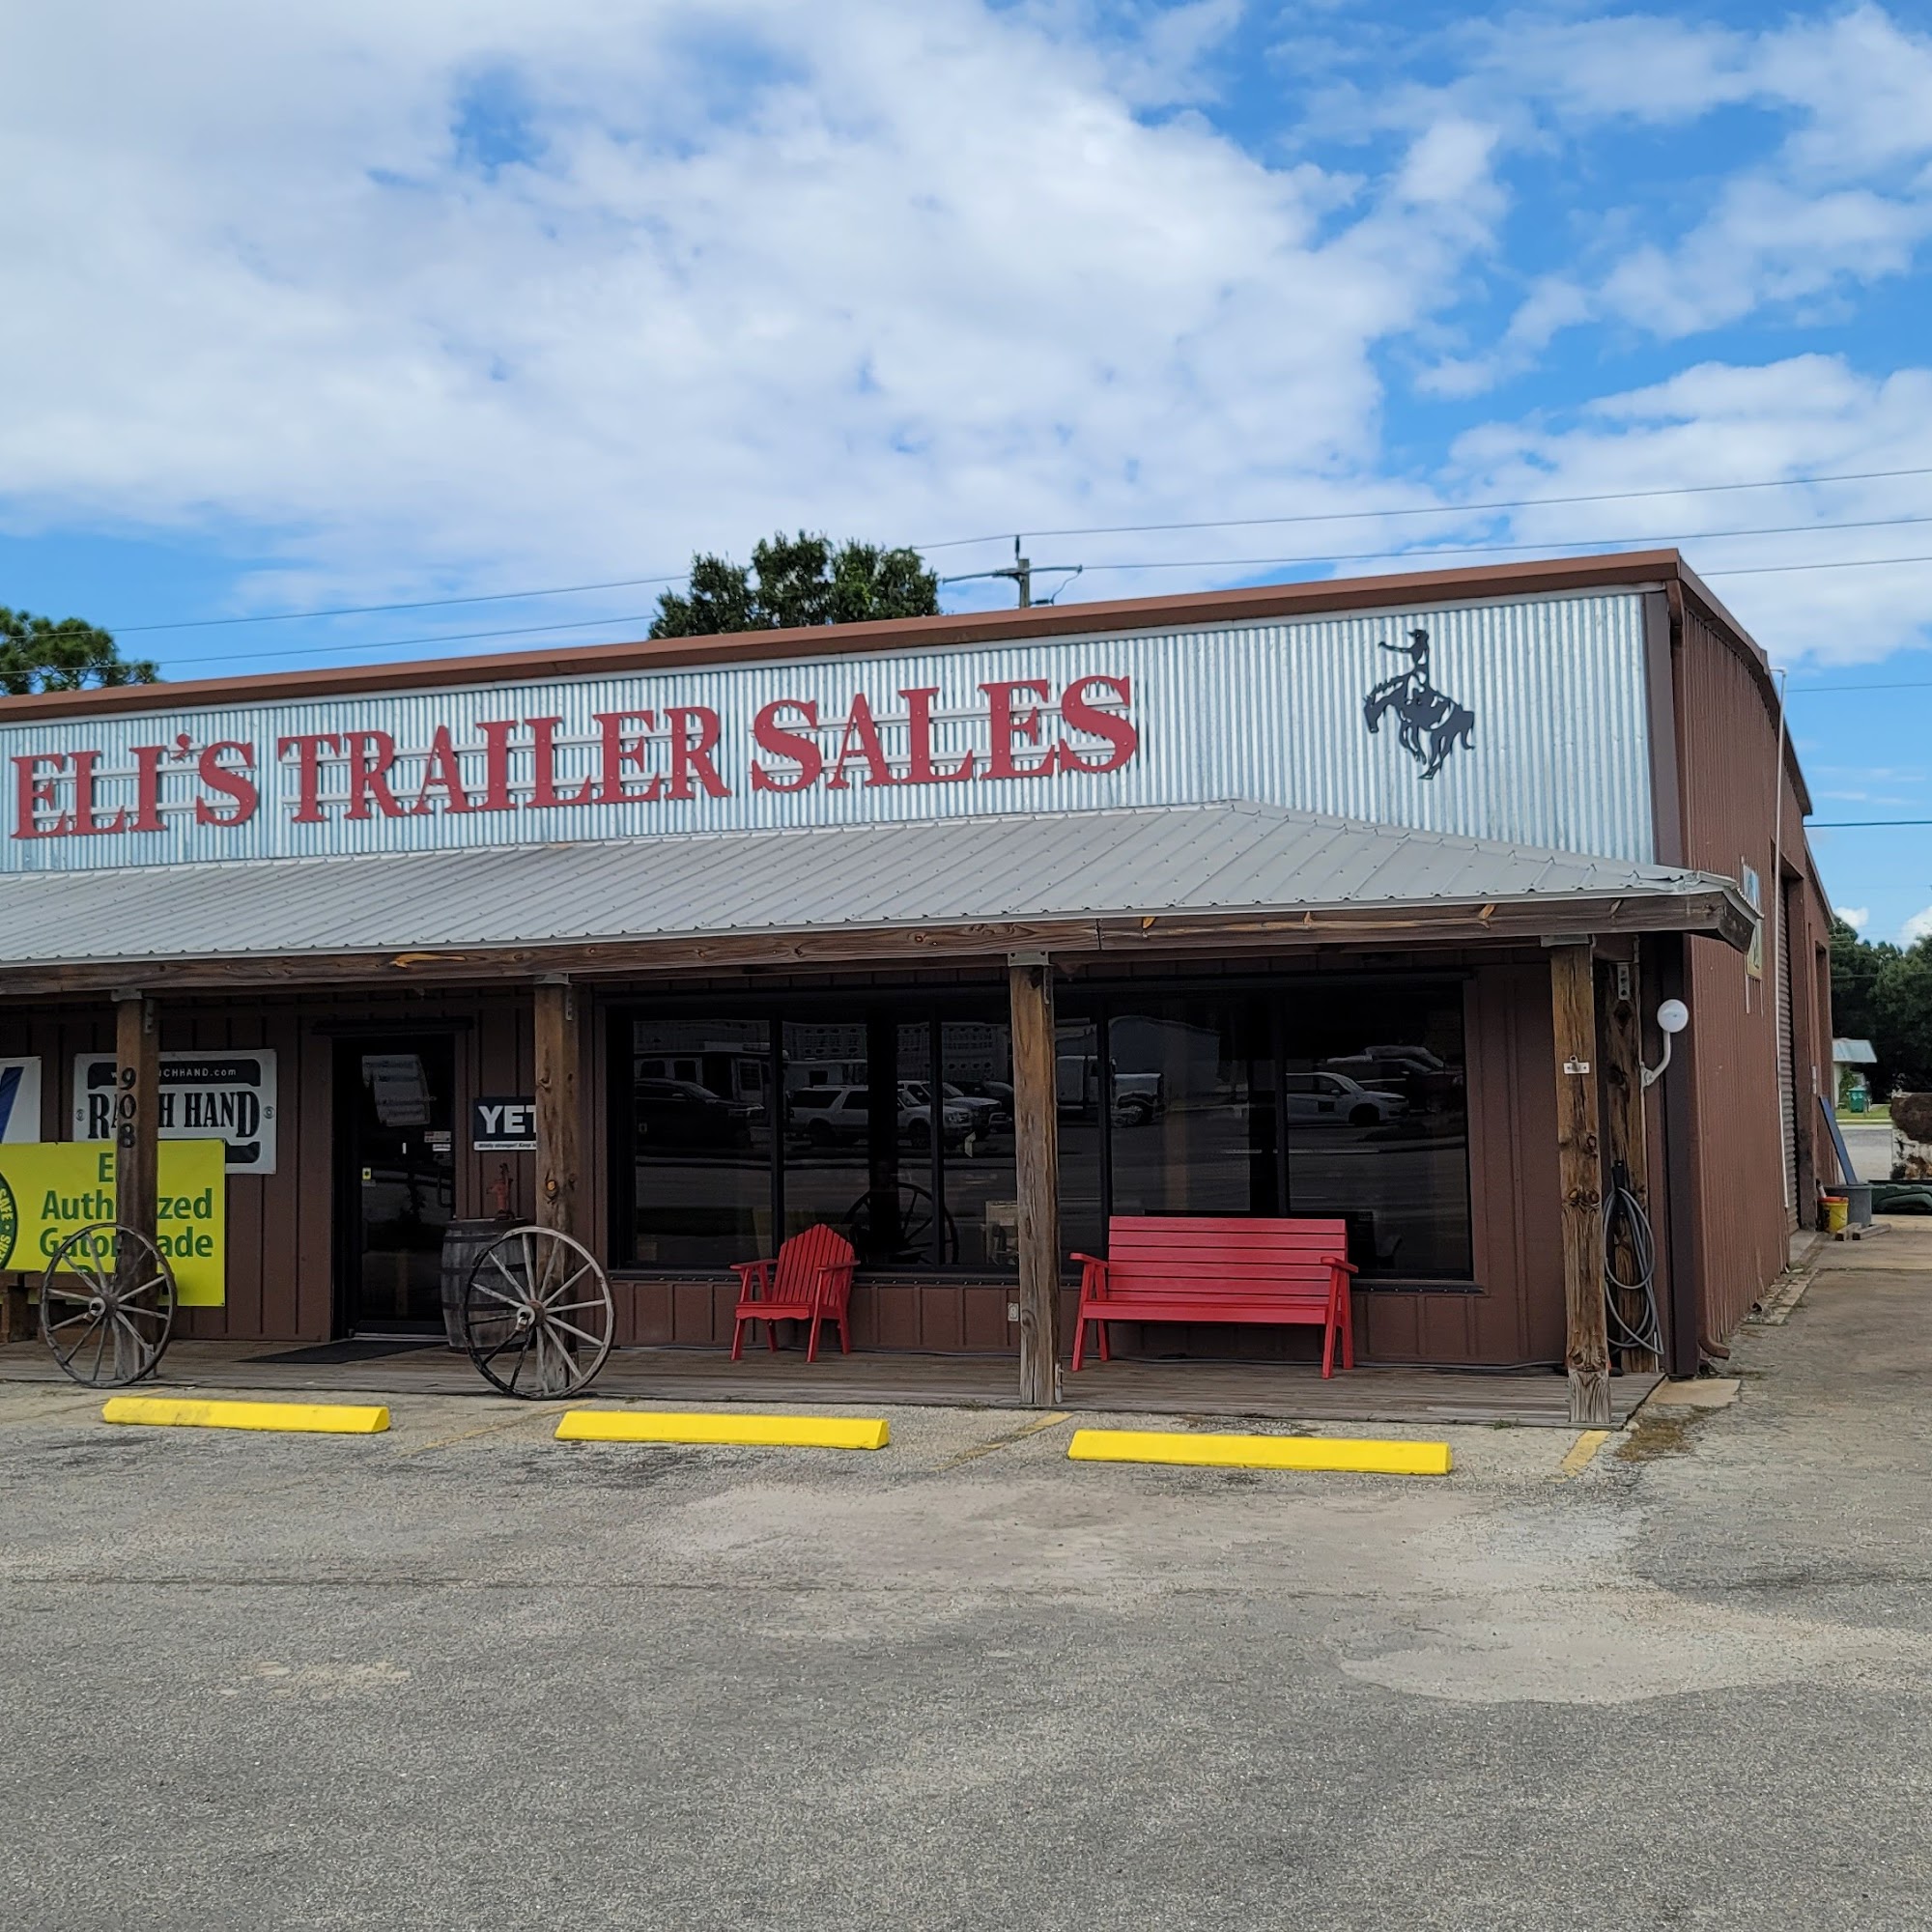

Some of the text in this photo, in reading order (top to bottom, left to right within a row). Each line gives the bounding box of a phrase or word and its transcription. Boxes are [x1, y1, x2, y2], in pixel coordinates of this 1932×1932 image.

[11, 676, 1137, 839] ELI'S TRAILER SALES
[119, 1066, 137, 1149] 908
[185, 1091, 260, 1138] HAND
[477, 1104, 537, 1134] YET
[41, 1188, 213, 1220] Authzed
